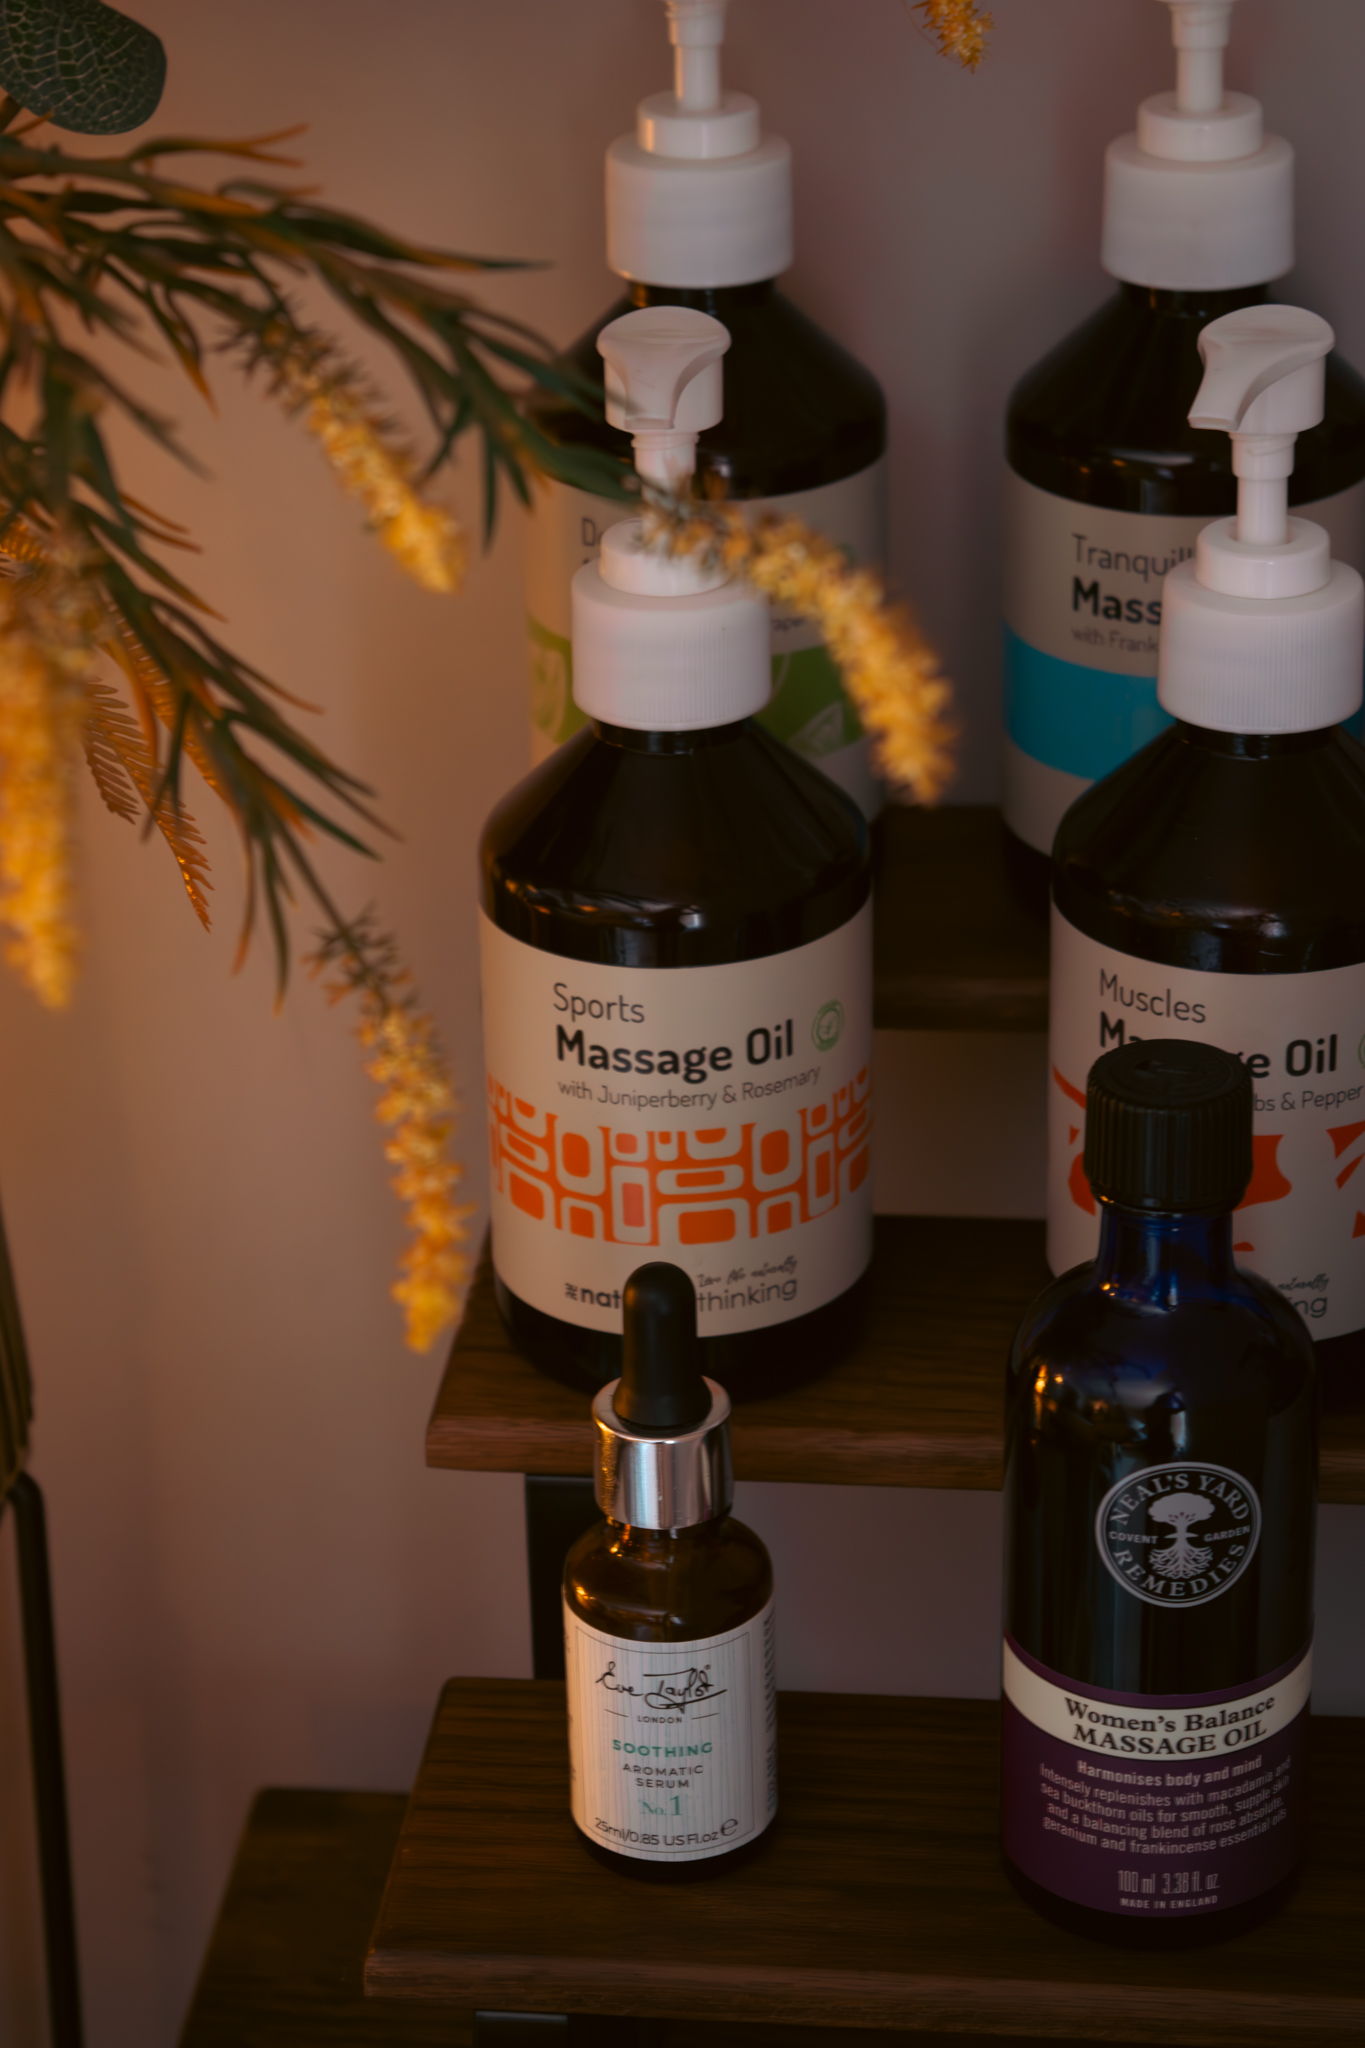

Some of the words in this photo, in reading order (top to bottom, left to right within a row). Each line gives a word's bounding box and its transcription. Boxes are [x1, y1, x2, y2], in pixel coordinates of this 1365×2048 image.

[1072, 577, 1161, 625] Mass
[1109, 630, 1159, 653] Frank
[553, 982, 645, 1023] Sports
[1100, 968, 1206, 1023] Muscles
[556, 1025, 733, 1084] Massage
[746, 1019, 793, 1065] Oil
[1285, 1034, 1337, 1077] Oil
[557, 1080, 592, 1100] with
[597, 1085, 718, 1112] Juniperberry
[722, 1084, 738, 1102] &
[741, 1066, 821, 1101] Rosemary
[1281, 1091, 1296, 1111] &
[1302, 1085, 1364, 1111] Pepper
[1109, 1473, 1190, 1526] NEAL'S
[1198, 1474, 1250, 1520] YARD
[1108, 1531, 1159, 1544] COVENT
[1202, 1524, 1250, 1542] GARDEN
[1113, 1544, 1246, 1597] REMEDIES
[637, 1716, 682, 1724] LONDON
[1064, 1697, 1176, 1732] Women's
[1185, 1697, 1275, 1731] Balance
[612, 1739, 712, 1758] SOOTHING
[1073, 1724, 1216, 1755] MASSAGE
[1223, 1720, 1267, 1747] OIL
[622, 1763, 703, 1776] AROMATIC
[636, 1777, 690, 1789] SERUM
[1039, 1763, 1091, 1797] Intensely
[1093, 1787, 1171, 1807] replenishes
[1174, 1787, 1204, 1806] with
[1207, 1770, 1273, 1803] macadamia
[1275, 1755, 1291, 1778] and
[1077, 1760, 1162, 1786] Harmonises
[1165, 1771, 1201, 1788] body
[1203, 1767, 1229, 1783] and
[1231, 1755, 1262, 1777] mind
[1040, 1782, 1060, 1800] sea
[1062, 1789, 1126, 1819] buckthorn
[1129, 1806, 1154, 1822] oils
[1157, 1806, 1177, 1823] for
[1180, 1803, 1232, 1823] smooth,
[1234, 1789, 1271, 1812] supple
[1272, 1774, 1290, 1795] skin
[1042, 1816, 1098, 1845] geranium
[1100, 1837, 1126, 1852] and
[1129, 1838, 1217, 1855] frankincense
[1219, 1819, 1270, 1848] essential
[1272, 1808, 1287, 1827] oils
[1047, 1801, 1069, 1820] and
[1071, 1813, 1080, 1825] a
[1082, 1814, 1147, 1840] balancing
[1150, 1824, 1189, 1839] blend
[1192, 1822, 1206, 1837] of
[1209, 1818, 1236, 1834] rose
[1117, 1870, 1139, 1893] 100
[1140, 1872, 1156, 1894] ml
[1120, 1897, 1150, 1909] MADE
[1153, 1900, 1166, 1909] IN
[1169, 1895, 1218, 1909] ENGLAND
